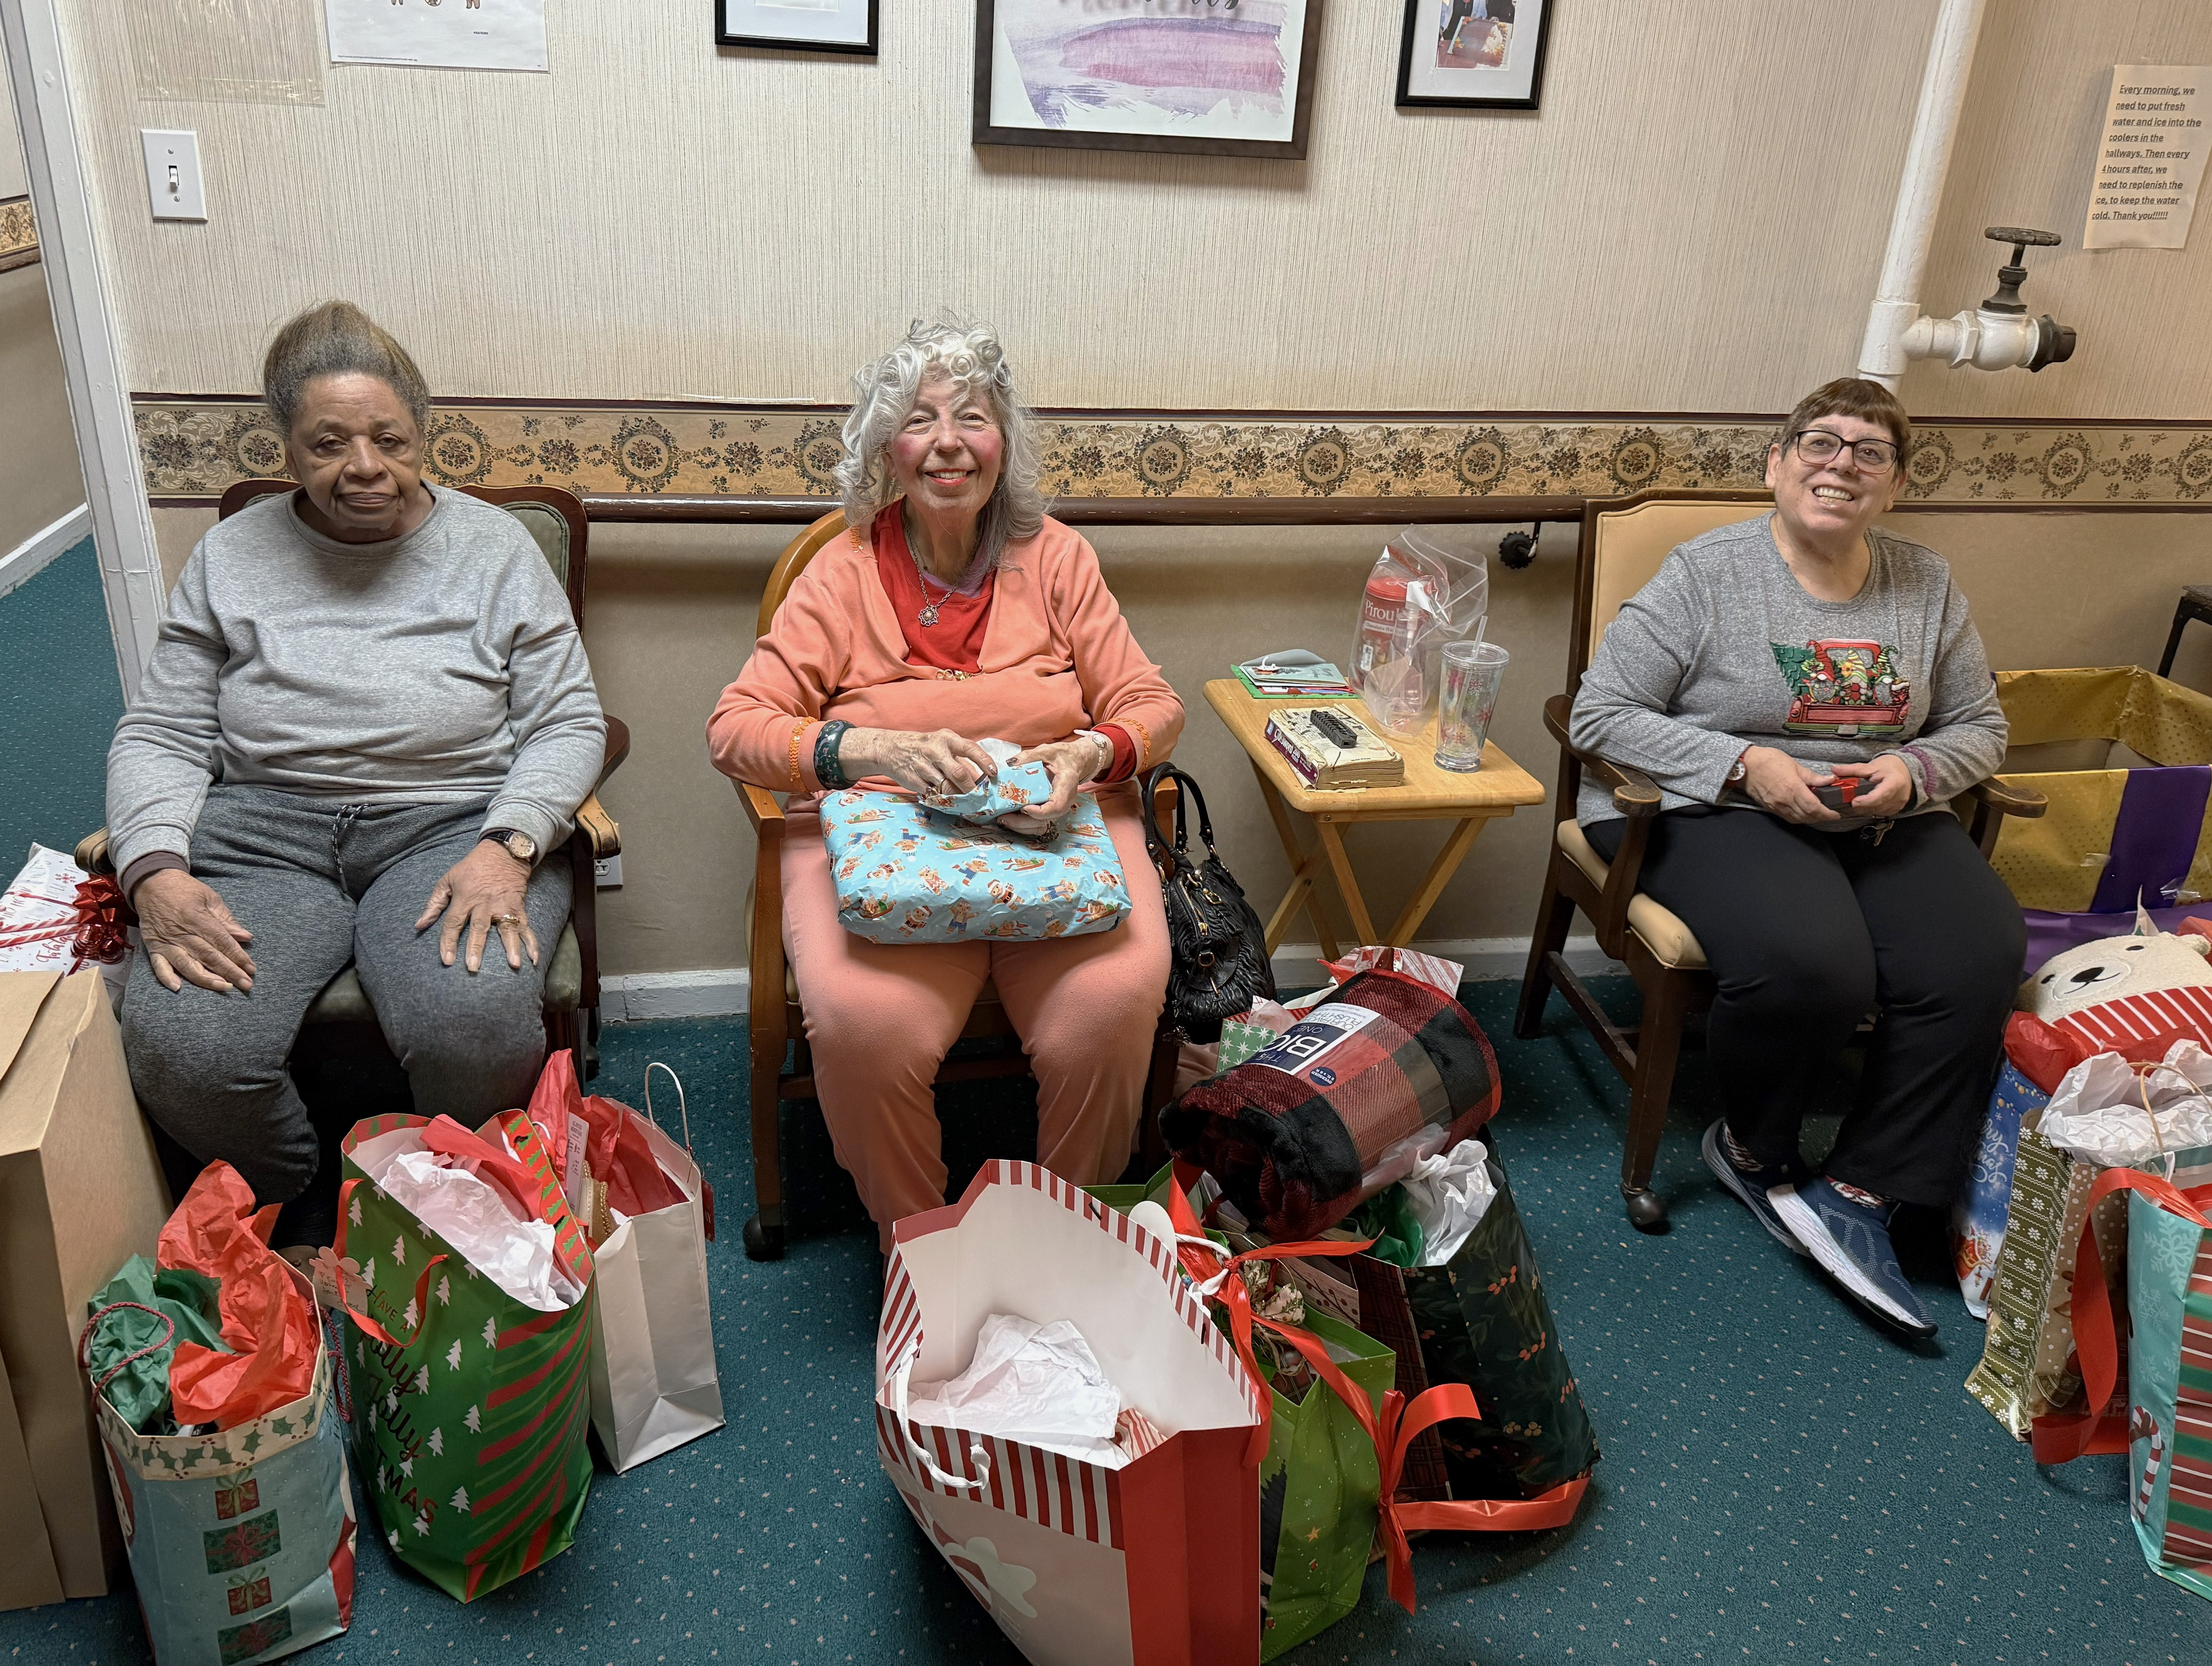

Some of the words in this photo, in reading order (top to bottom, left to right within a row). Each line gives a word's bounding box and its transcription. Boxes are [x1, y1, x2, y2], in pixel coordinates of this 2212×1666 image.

[2120, 85, 2142, 95] Every
[2143, 86, 2181, 96] morning,
[2116, 101, 2136, 110] need
[2148, 102, 2163, 111] put
[2164, 102, 2185, 111] fresh
[2154, 117, 2167, 126] ice
[2168, 118, 2184, 126] into
[2186, 118, 2202, 127] the
[2109, 133, 2139, 142] coolers
[2140, 133, 2148, 142] in
[2151, 133, 2164, 142] the
[2105, 149, 2143, 158] hallways.
[2145, 149, 2165, 158] Then
[2132, 165, 2153, 174] after,
[2099, 180, 2118, 189] need
[2129, 181, 2167, 190] replenish
[2095, 196, 2107, 204] ice,
[2120, 196, 2140, 205] keep
[2092, 211, 2110, 219] cold.
[2113, 211, 2137, 219] Thank
[1331, 1013, 1362, 1026] PLUSH
[1293, 1025, 1323, 1033] ONE
[1255, 1053, 1282, 1062] THE
[1311, 1071, 1333, 1084] OVERSIZED
